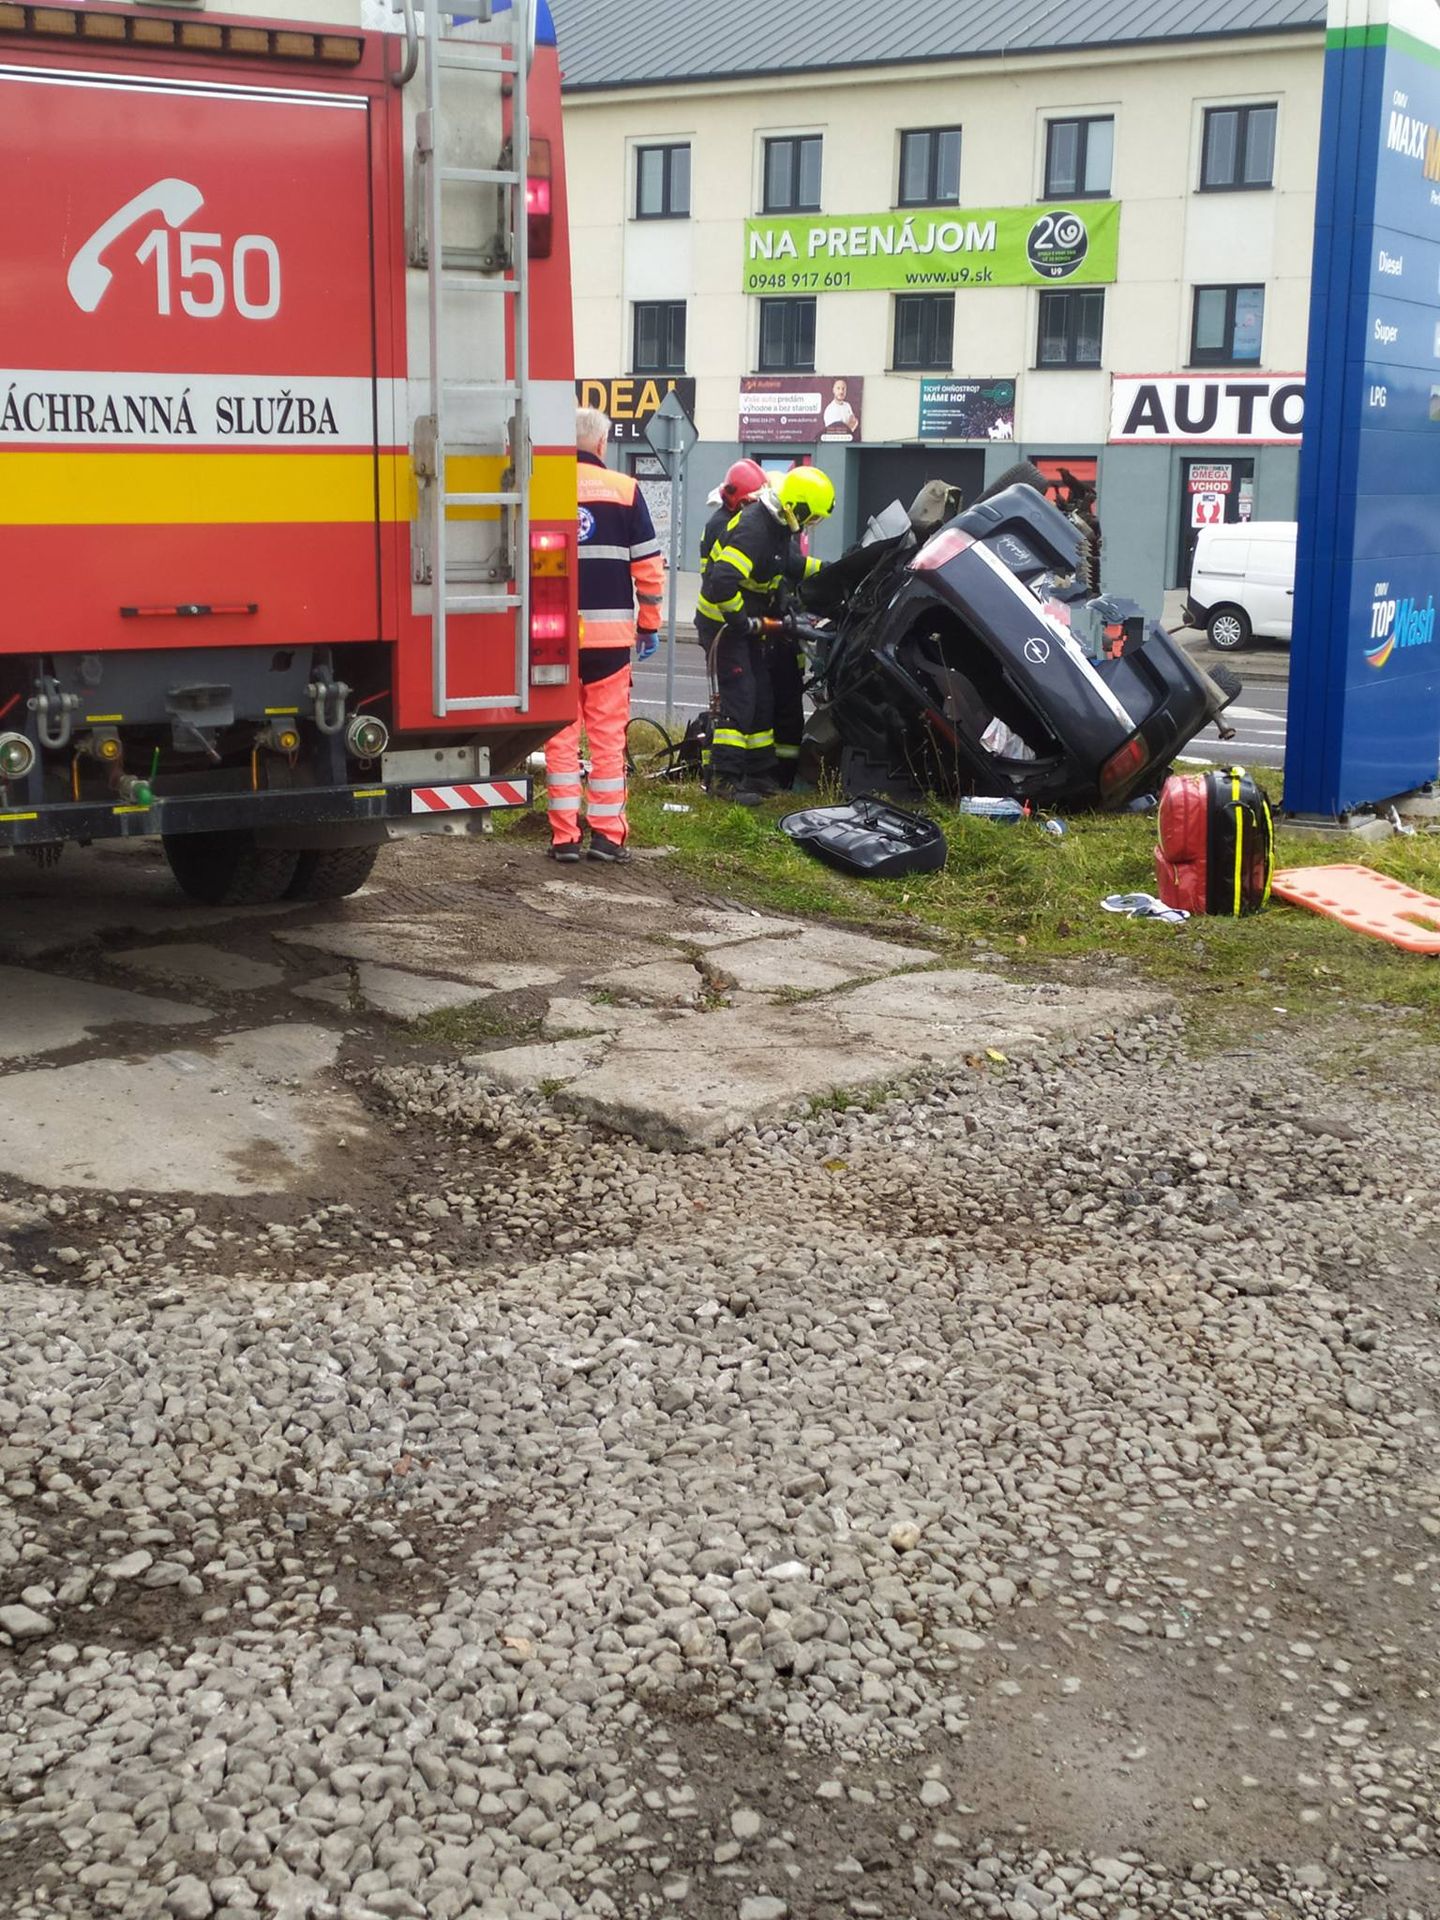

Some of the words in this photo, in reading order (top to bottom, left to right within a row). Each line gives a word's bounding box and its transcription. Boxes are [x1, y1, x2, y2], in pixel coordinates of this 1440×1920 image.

[750, 230, 798, 260] NA
[808, 216, 997, 258] PRENÁJOM
[135, 229, 281, 319] 150
[906, 266, 992, 283] www.u9.sk
[1378, 250, 1403, 276] Diesel
[749, 274, 786, 288] 0948
[792, 273, 819, 287] 917
[824, 271, 851, 286] 601
[1374, 318, 1398, 345] Super
[582, 380, 676, 418] DEA
[1370, 385, 1387, 407] LPG
[216, 389, 339, 434] SLUŽBA
[1191, 482, 1229, 491] VCHOD
[1192, 471, 1229, 479] OMEGA
